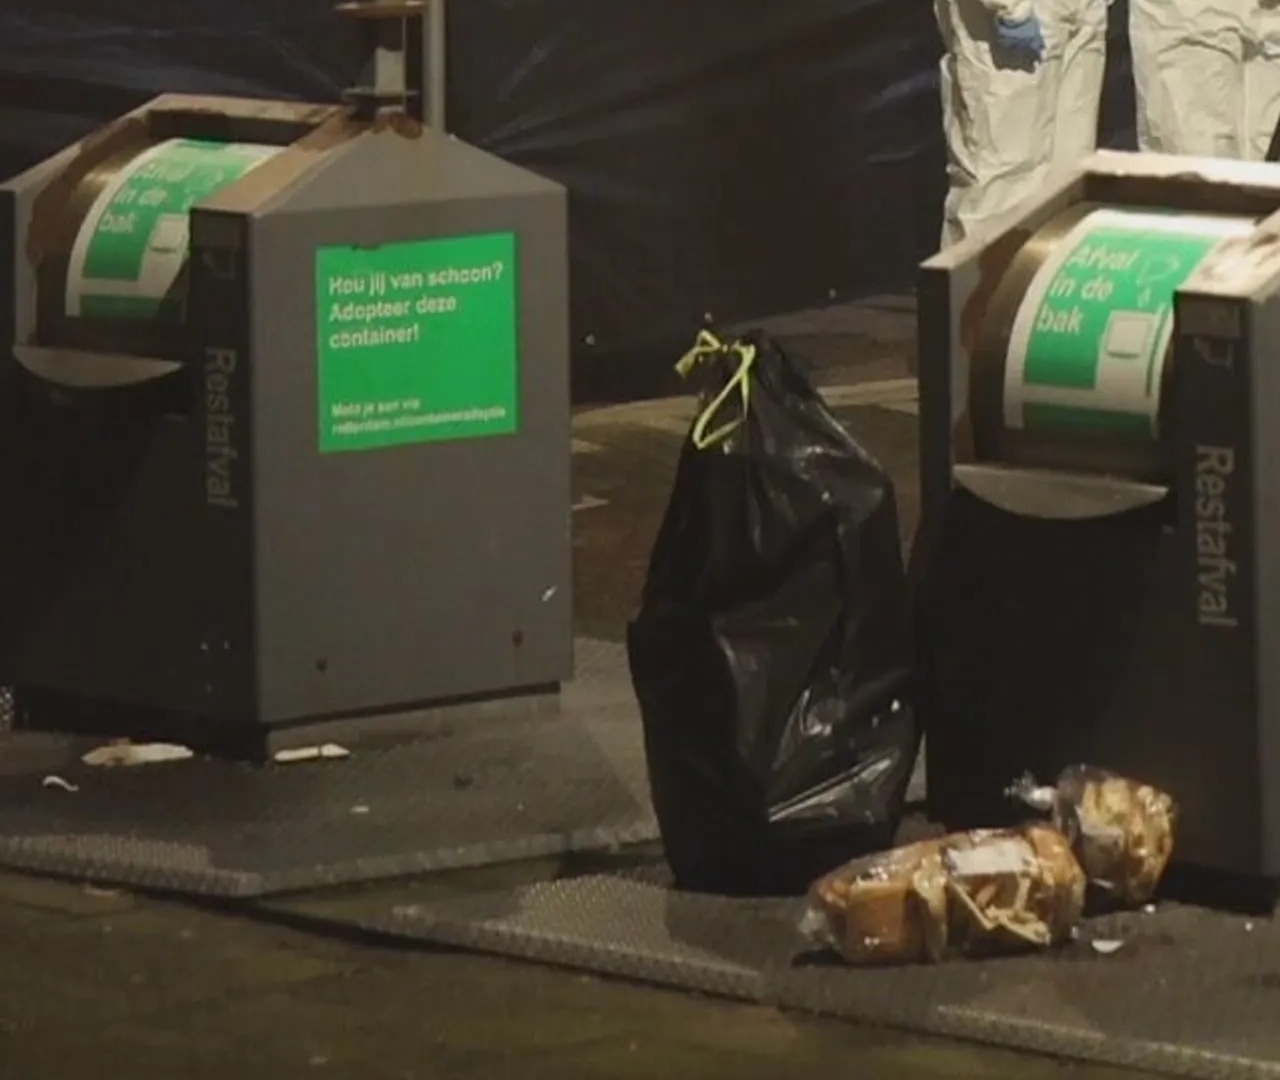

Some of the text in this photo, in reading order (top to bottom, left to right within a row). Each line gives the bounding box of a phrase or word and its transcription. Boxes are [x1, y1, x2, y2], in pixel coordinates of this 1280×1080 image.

[328, 260, 505, 297] Hou jij van schoon?
[1049, 270, 1077, 299] in
[328, 294, 458, 324] Adopteer deze
[1036, 302, 1085, 337] bak
[328, 322, 420, 351] container!
[204, 347, 238, 509] Restafval
[1195, 444, 1240, 627] Restafval
